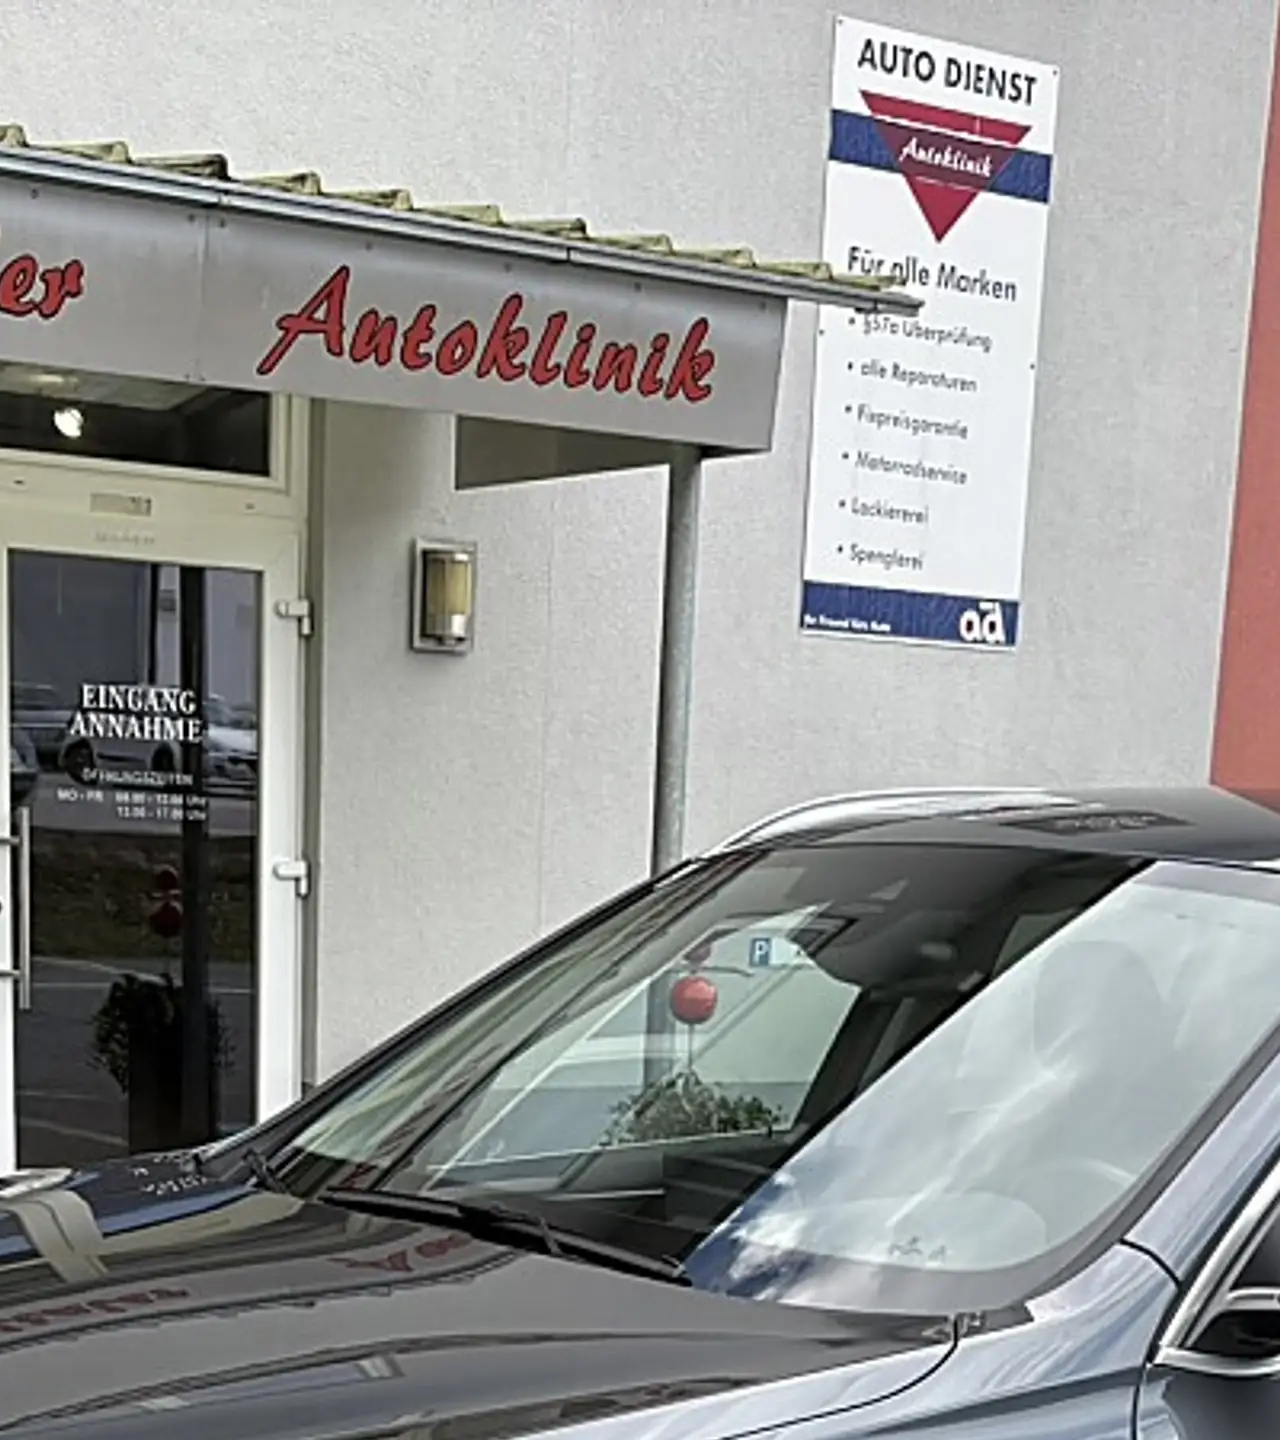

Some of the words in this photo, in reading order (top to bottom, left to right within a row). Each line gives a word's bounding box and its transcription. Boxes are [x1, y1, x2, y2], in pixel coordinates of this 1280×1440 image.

[857, 37, 936, 83] AUTO
[944, 56, 1037, 106] DIENST
[898, 137, 994, 178] Autoklinik
[847, 246, 885, 276] Für
[889, 255, 930, 288] alle
[936, 261, 1018, 302] Marken
[256, 264, 717, 402] Autoklinik
[81, 684, 197, 715] EINGANG
[70, 711, 204, 744] ANNAHME
[753, 940, 770, 963] P
